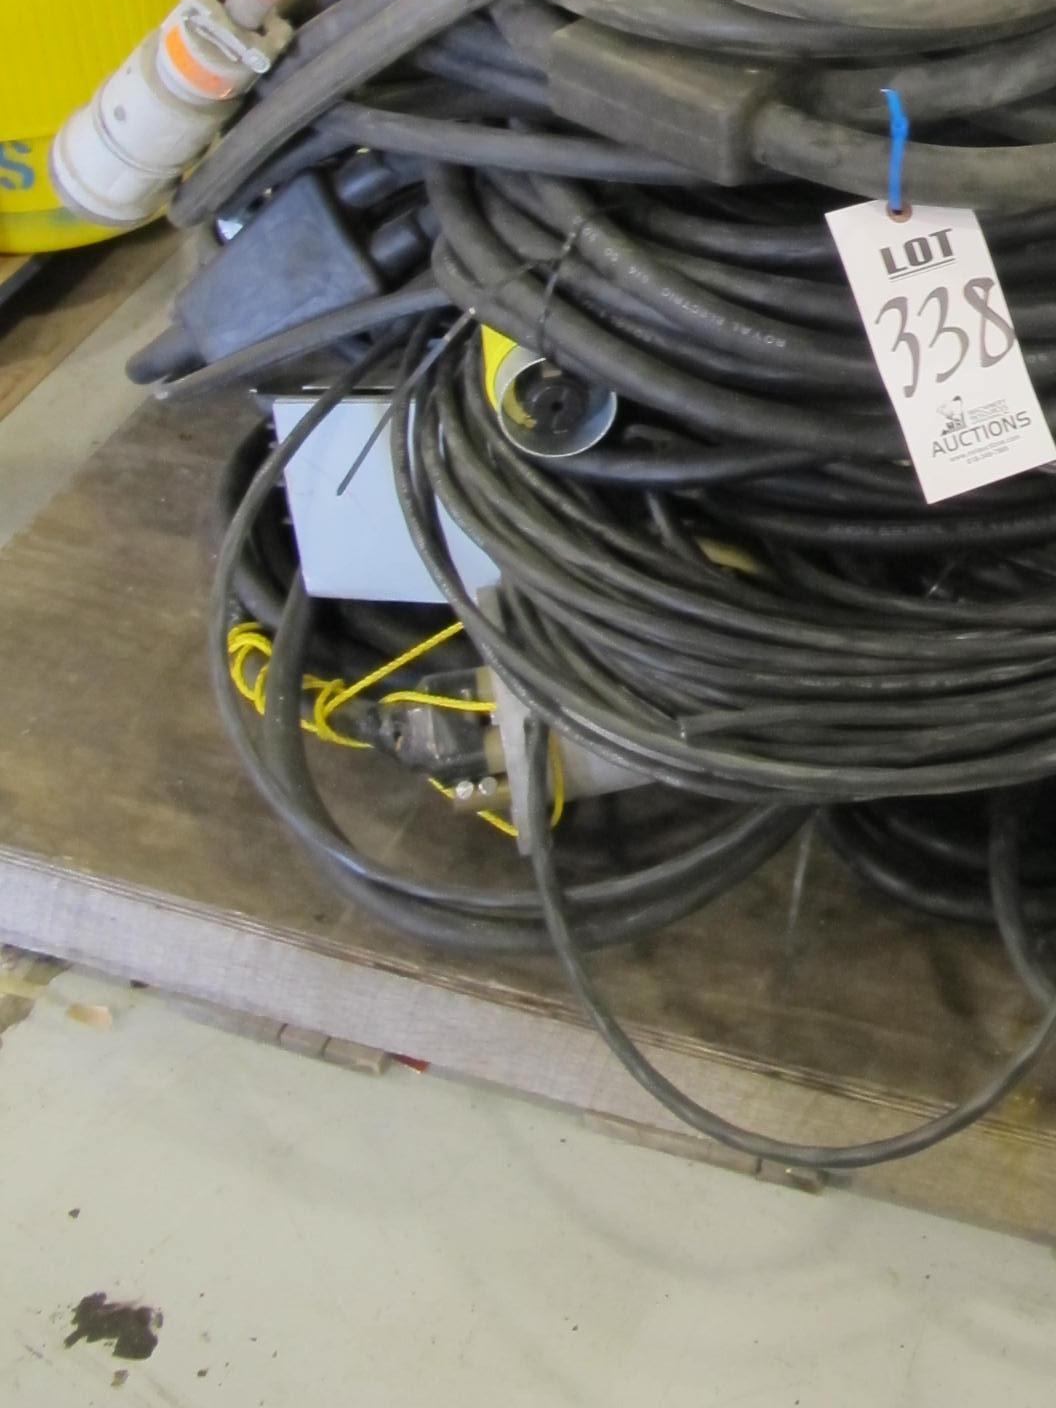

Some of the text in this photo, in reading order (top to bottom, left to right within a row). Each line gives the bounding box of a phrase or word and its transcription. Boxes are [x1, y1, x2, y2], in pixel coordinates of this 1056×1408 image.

[879, 228, 953, 275] LOT
[874, 276, 1016, 398] 338
[931, 410, 1032, 459] AUCTIONS
